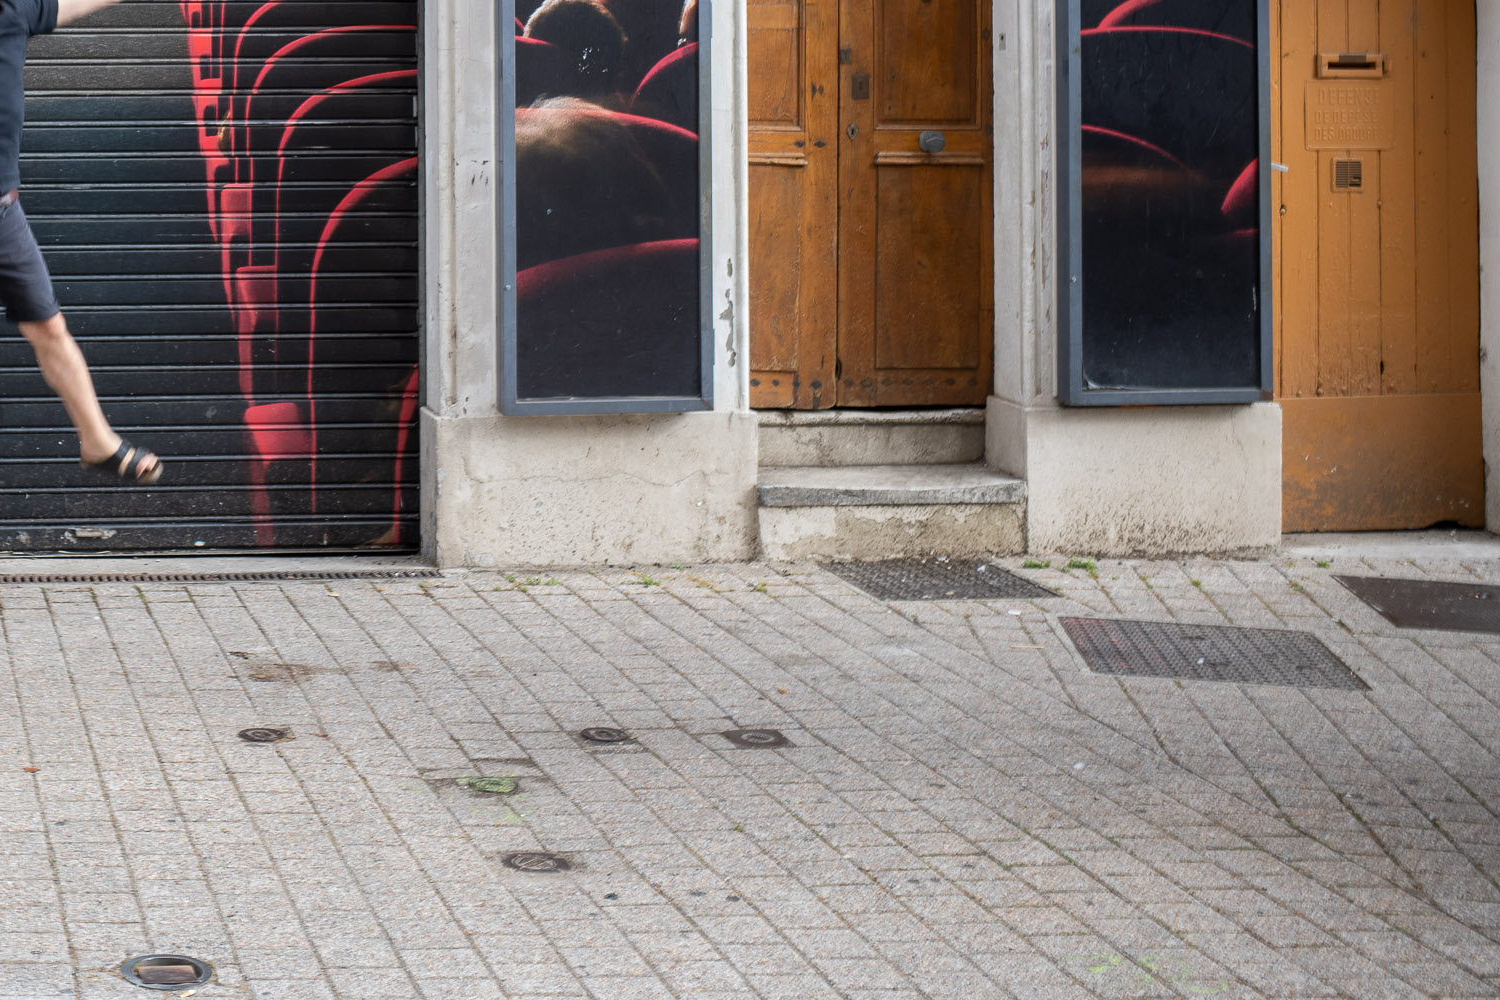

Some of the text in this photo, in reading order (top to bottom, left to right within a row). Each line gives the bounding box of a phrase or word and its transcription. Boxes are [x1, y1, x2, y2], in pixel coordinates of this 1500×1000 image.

[1318, 87, 1381, 105] DEFENSE
[1314, 110, 1332, 125] DE
[1314, 126, 1334, 141] DES
